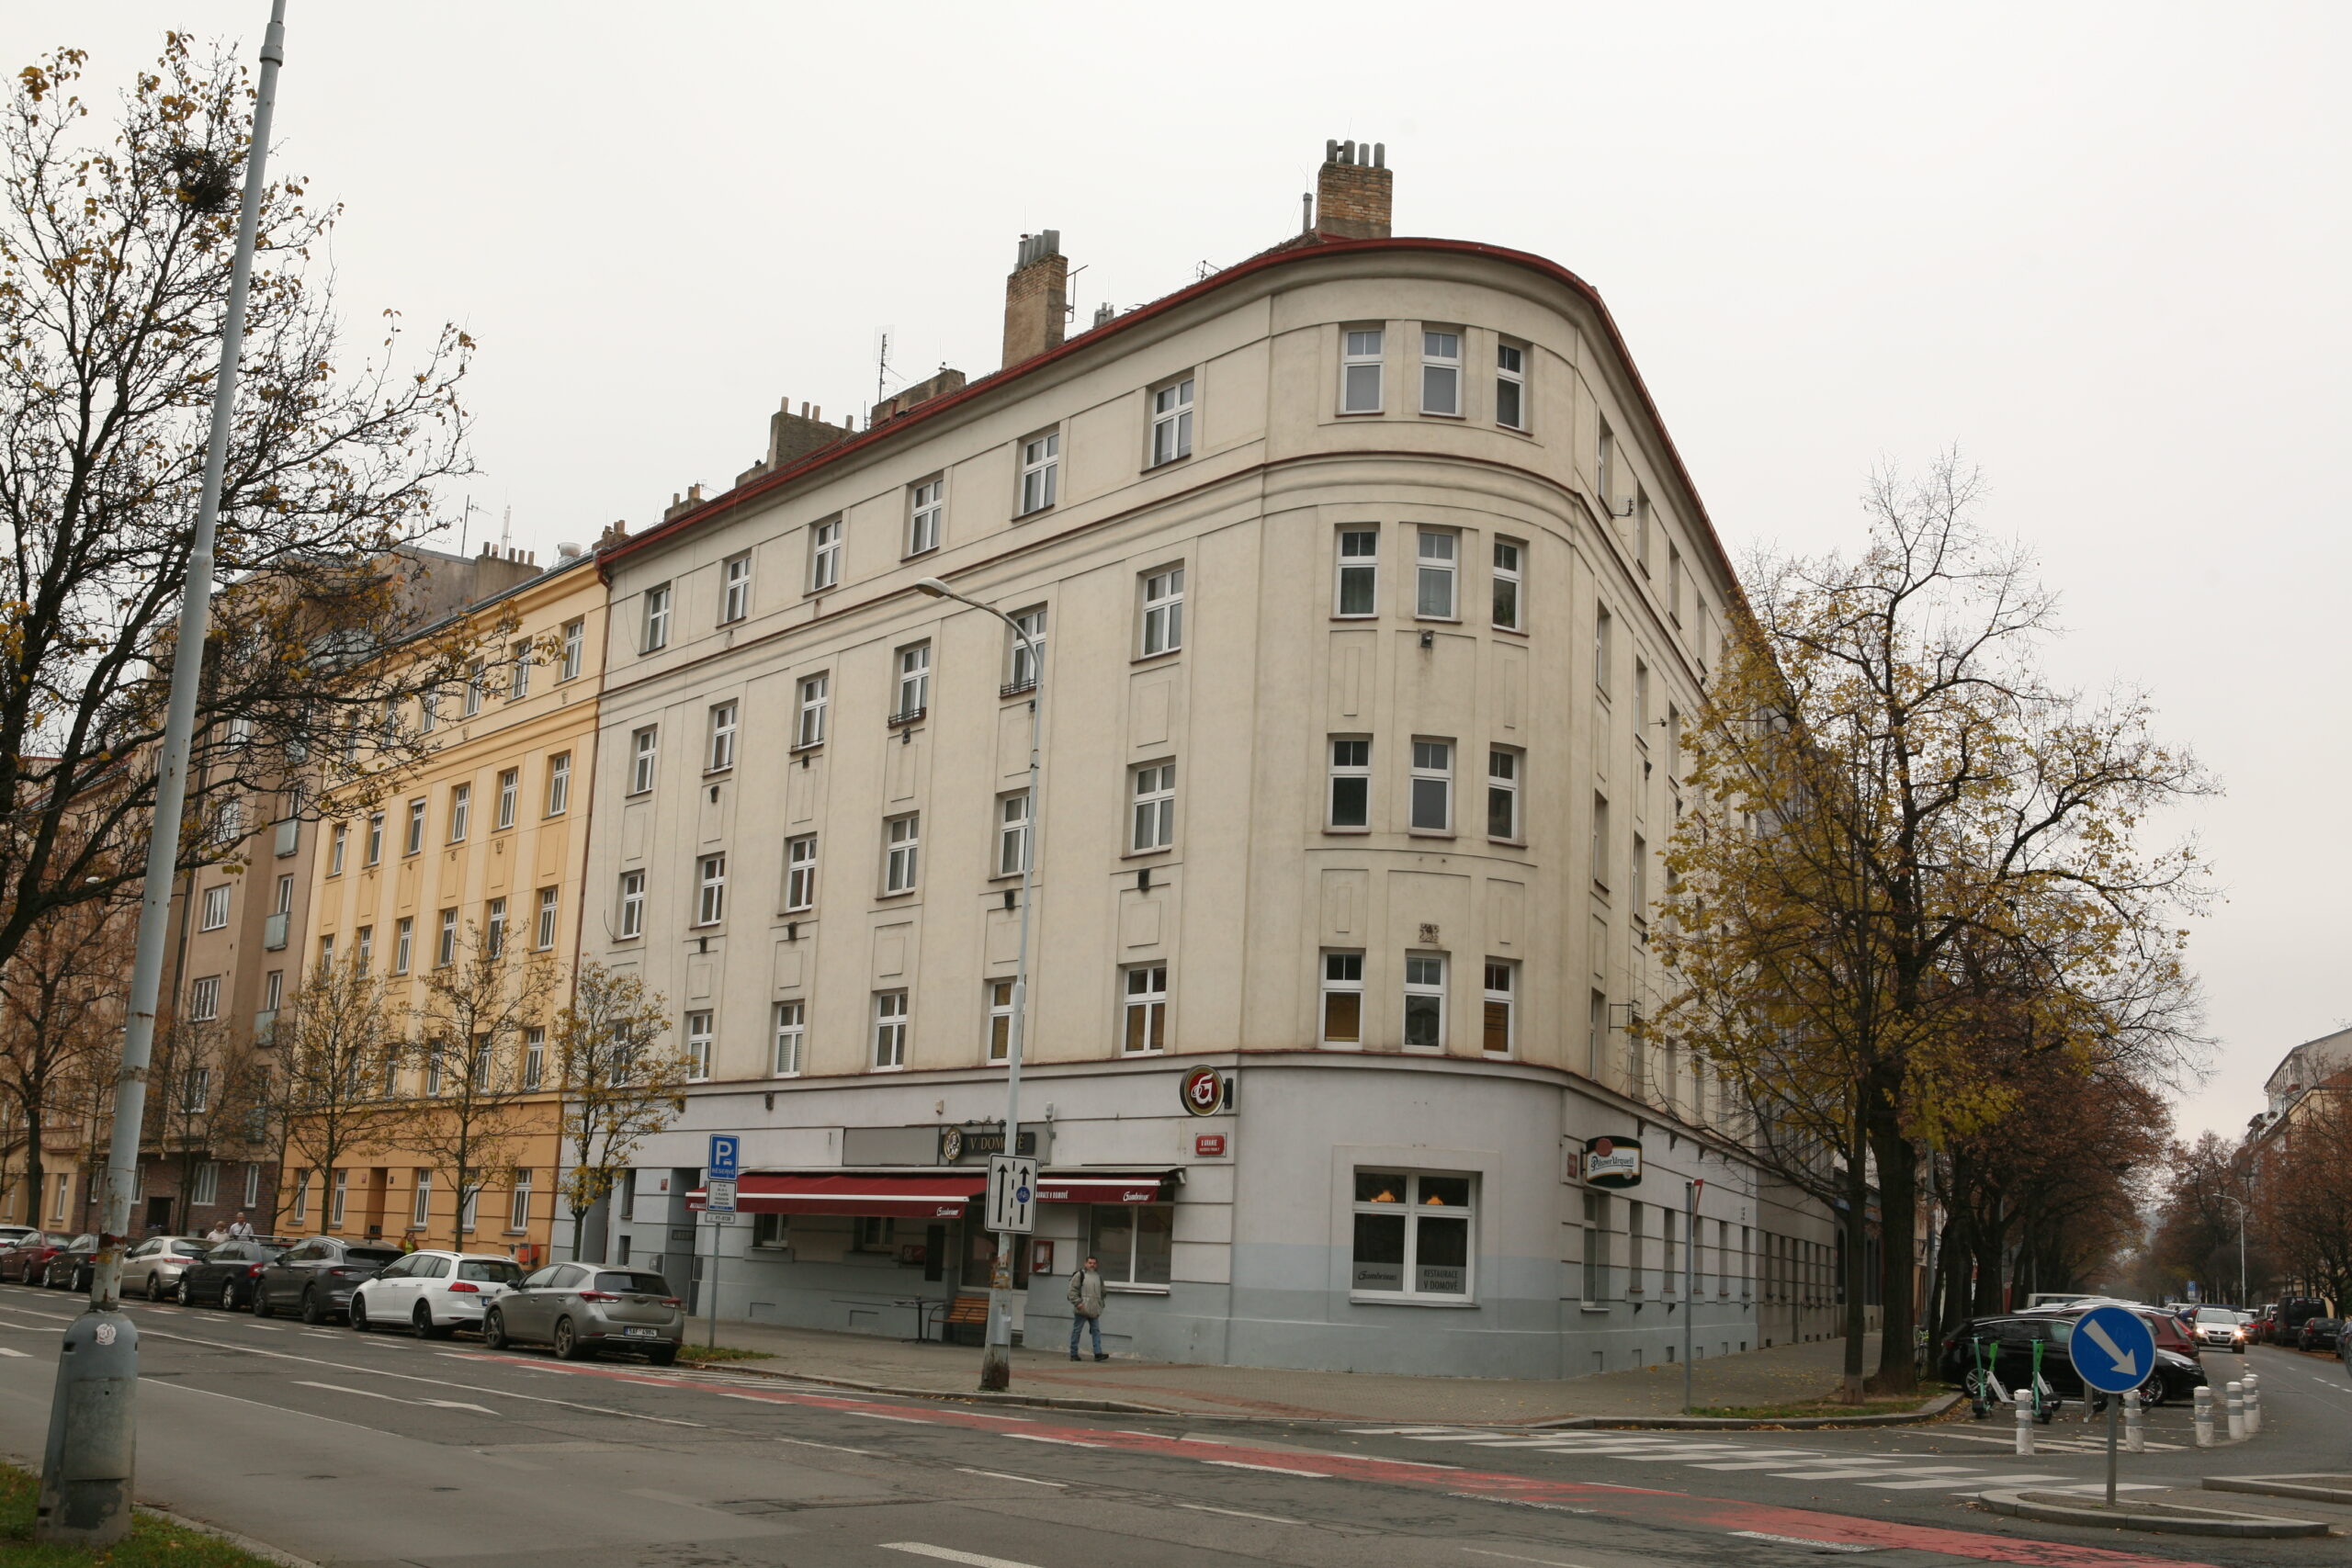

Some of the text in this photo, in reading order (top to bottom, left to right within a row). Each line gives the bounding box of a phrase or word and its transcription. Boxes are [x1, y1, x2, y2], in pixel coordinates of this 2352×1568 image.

[970, 1134, 1024, 1150] V DOMĚ
[716, 1141, 732, 1165] P
[1590, 1156, 1612, 1171] Pilsner
[1612, 1156, 1634, 1167] Urquell
[1358, 1270, 1397, 1280] Gambrinus
[1423, 1269, 1458, 1279] RESTAURACE
[1423, 1281, 1428, 1290] V
